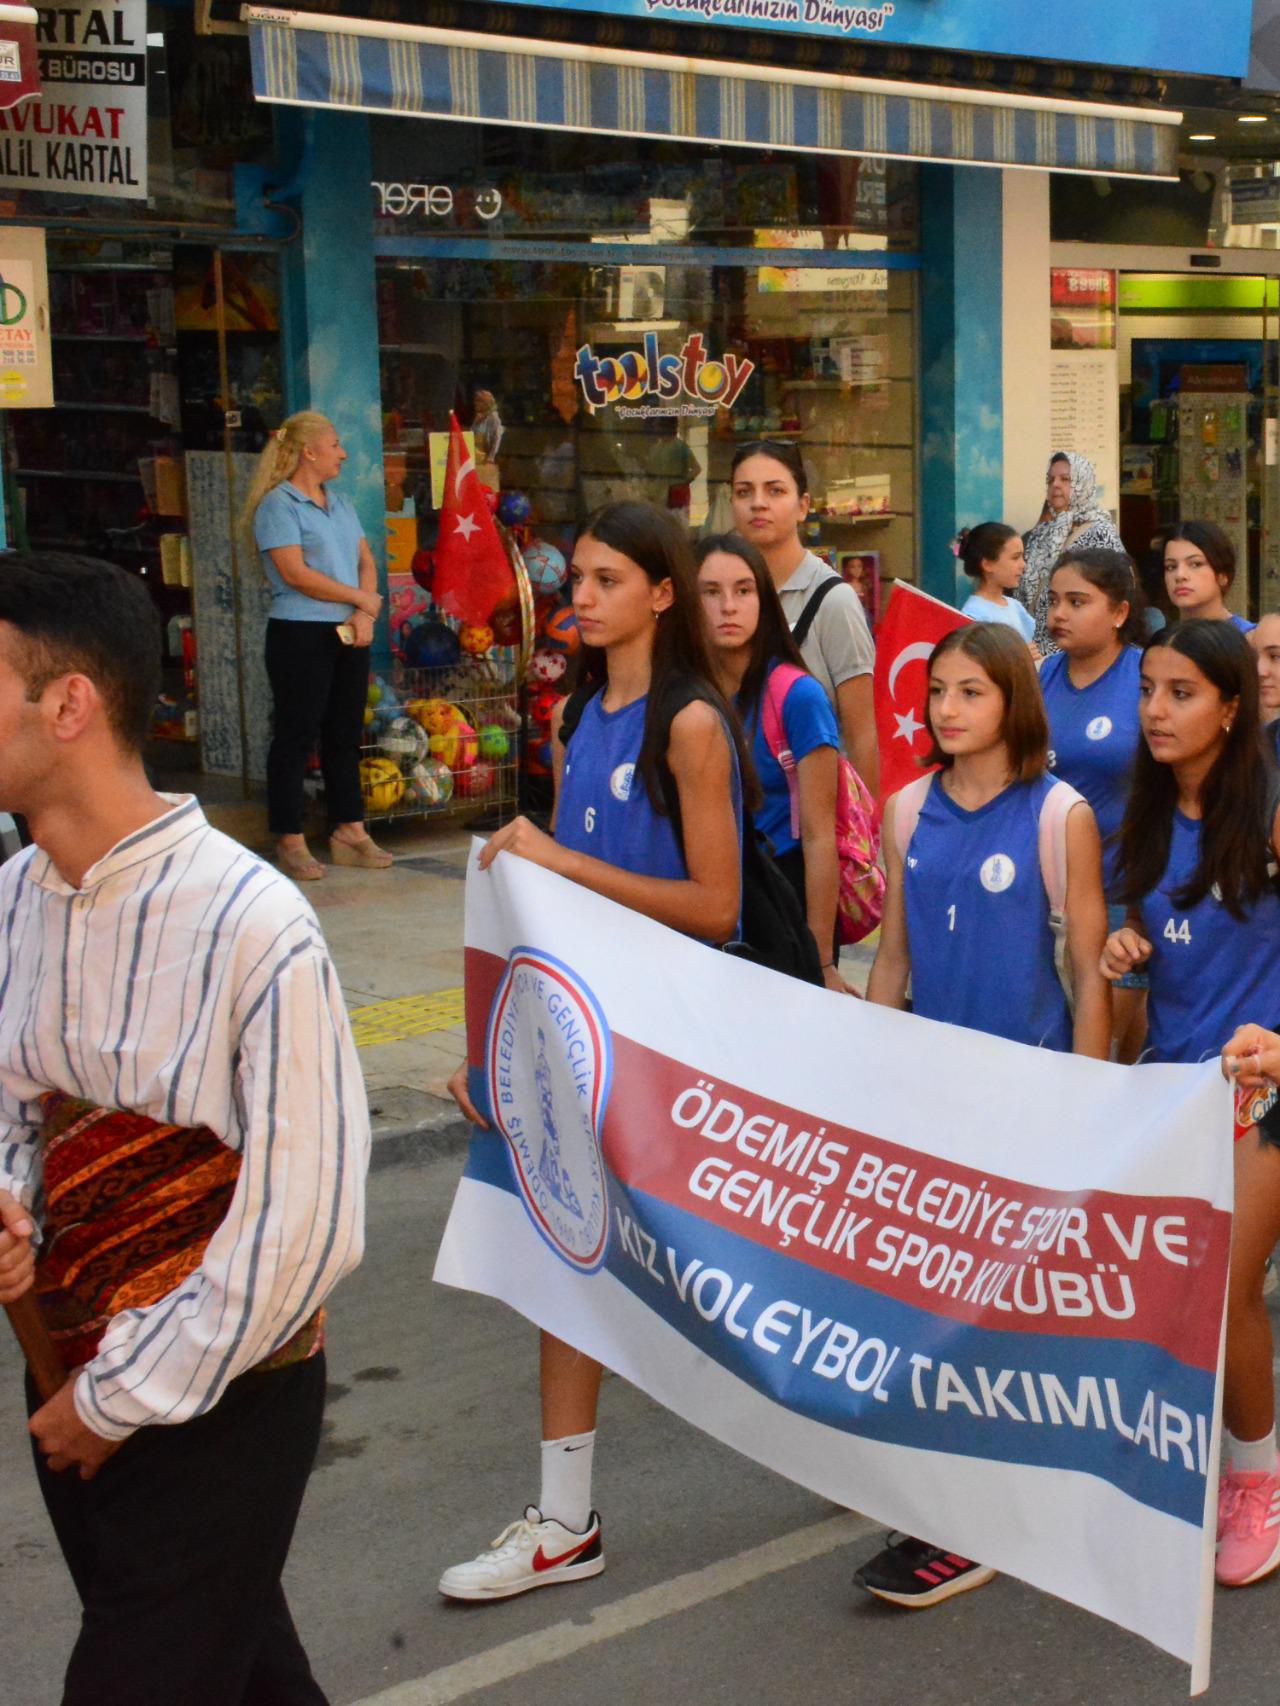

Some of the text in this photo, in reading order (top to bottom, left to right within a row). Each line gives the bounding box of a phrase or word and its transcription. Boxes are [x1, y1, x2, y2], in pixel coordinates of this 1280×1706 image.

[49, 55, 136, 82] BÜROSU
[0, 102, 125, 139] VUKAT
[46, 141, 140, 186] KARTAL
[574, 331, 755, 409] toolstoy
[584, 806, 597, 833] 6
[946, 904, 956, 931] 1
[1163, 917, 1192, 945] 44
[670, 1078, 848, 1196] ÖDEMİŞ
[848, 1151, 1017, 1245] BELEDİYE
[1017, 1205, 1093, 1260] SPOR
[1101, 1211, 1189, 1267] VE
[688, 1154, 873, 1262] GENÇLİK
[866, 1226, 967, 1302] SPOR
[964, 1255, 1138, 1321] KULÜBÜ
[615, 1206, 667, 1286] KIZ
[665, 1245, 902, 1403] VOLEYBOL
[906, 1352, 1211, 1476] TAKIMLARI
